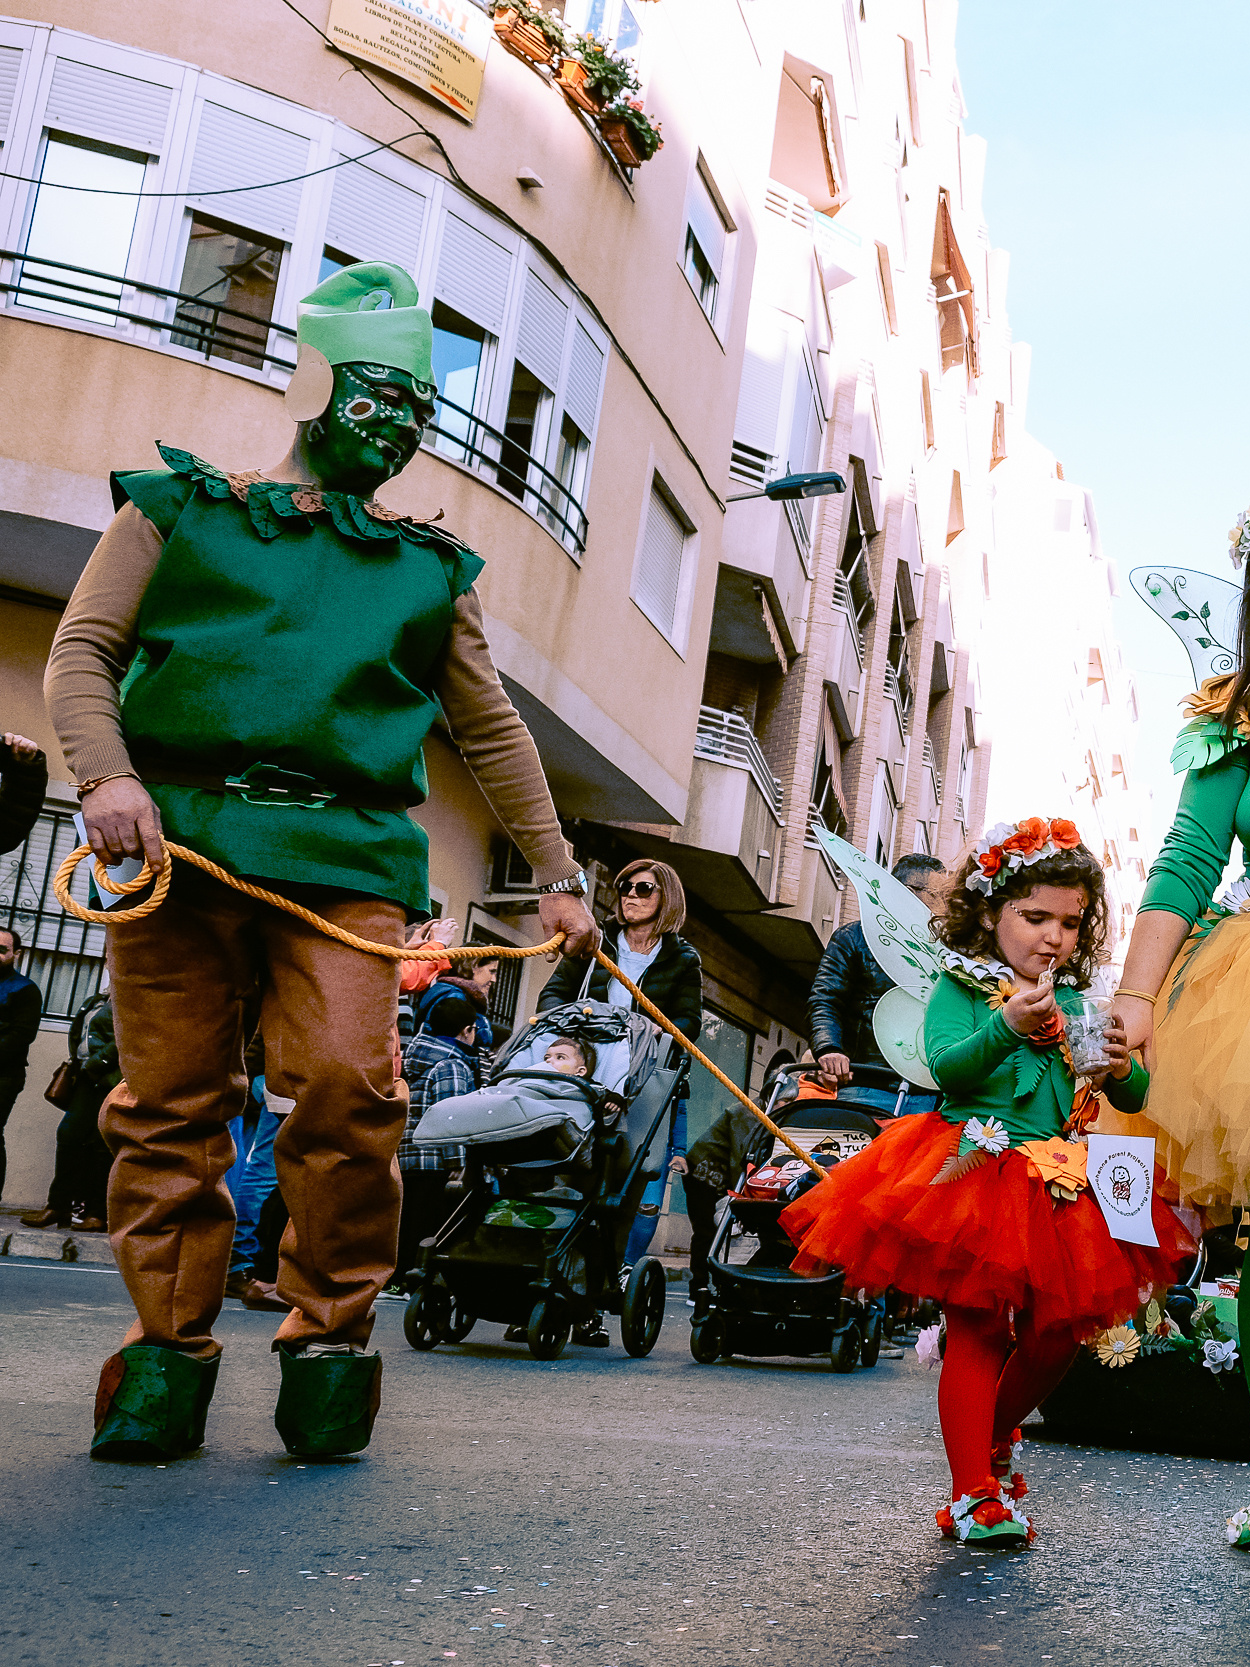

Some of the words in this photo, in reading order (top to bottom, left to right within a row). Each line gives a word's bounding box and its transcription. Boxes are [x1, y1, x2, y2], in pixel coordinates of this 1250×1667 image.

[365, 6, 391, 22] LIBROS
[393, 19, 402, 28] DE
[404, 25, 427, 41] TEXTO
[434, 42, 461, 64] LECTURA
[389, 6, 422, 28] ESCOLAR
[429, 28, 475, 63] COMPLEMENTOS
[390, 29, 417, 46] BELLAS
[427, 14, 464, 41] JOVEN
[333, 25, 361, 42] BODAS,
[363, 38, 402, 61] BAUTIZOS,
[403, 57, 445, 86] COMUNIONES
[451, 86, 473, 106] FIESTAS
[380, 34, 409, 53] REGALO
[411, 49, 443, 73] INFORMAL
[1108, 1151, 1126, 1161] Parent
[1127, 1152, 1146, 1168] Project
[1143, 1169, 1151, 1195] España
